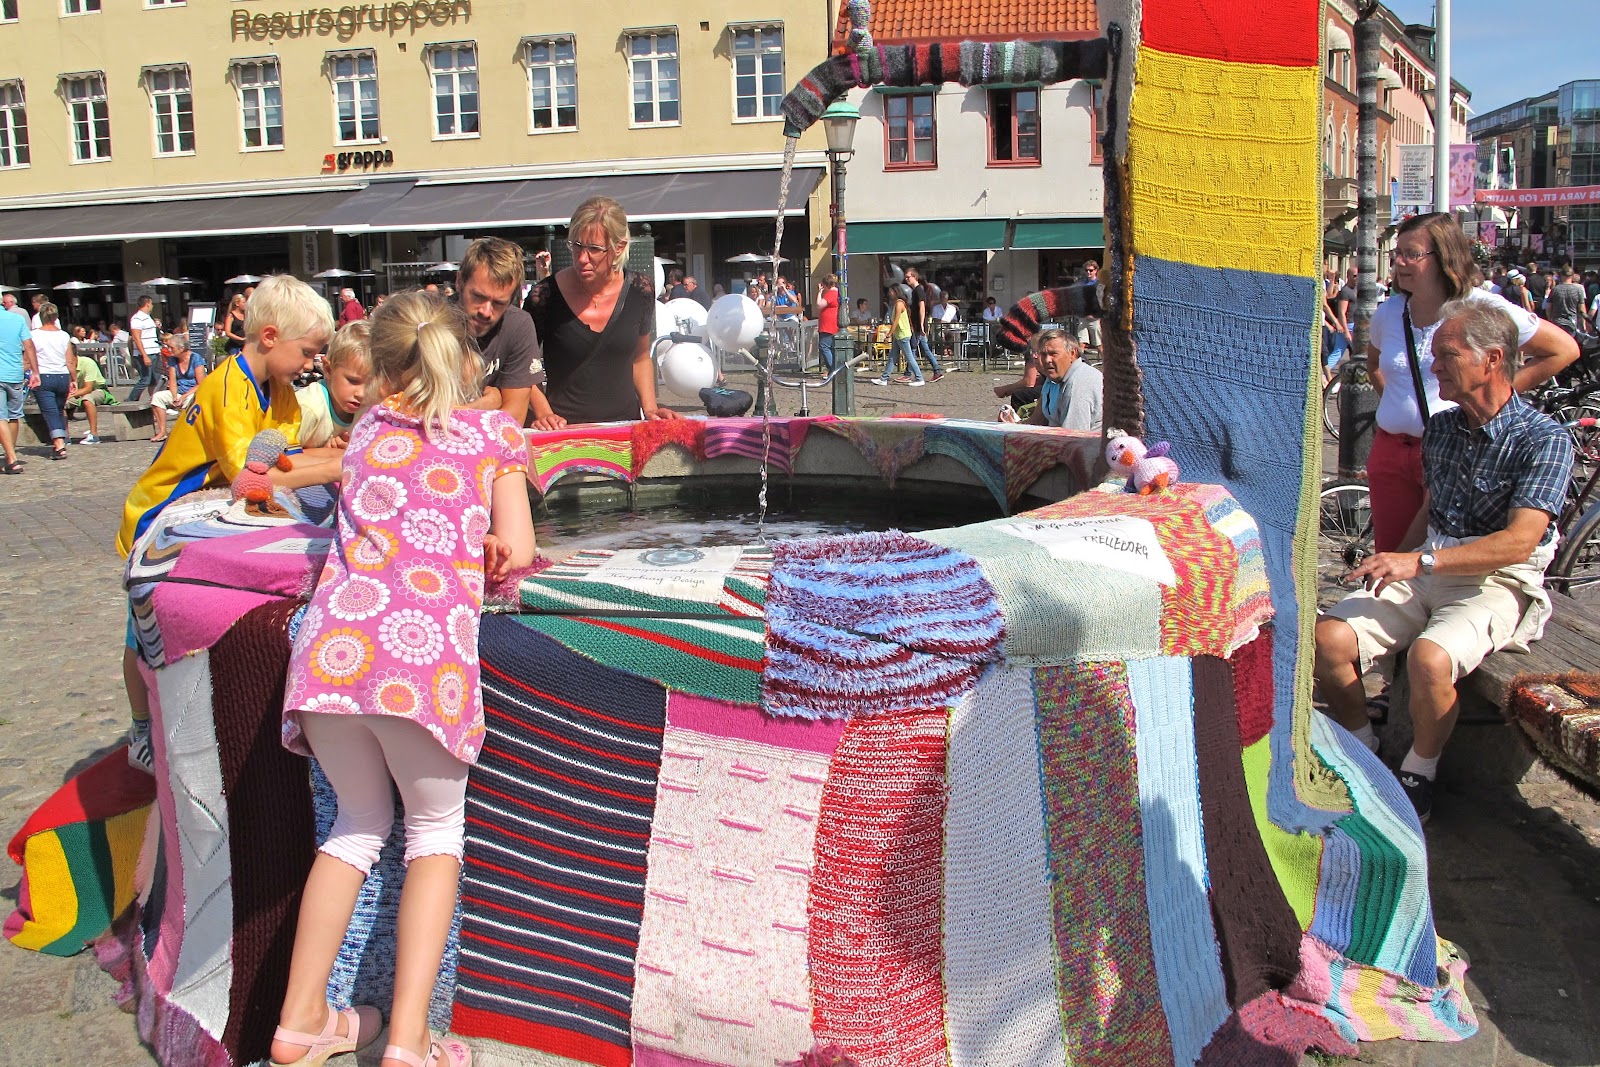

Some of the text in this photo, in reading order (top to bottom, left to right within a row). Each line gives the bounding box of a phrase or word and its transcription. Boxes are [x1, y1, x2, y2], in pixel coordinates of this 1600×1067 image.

[232, 0, 471, 41] Resursgruppen
[338, 149, 394, 170] grappa
[670, 576, 705, 588] Design
